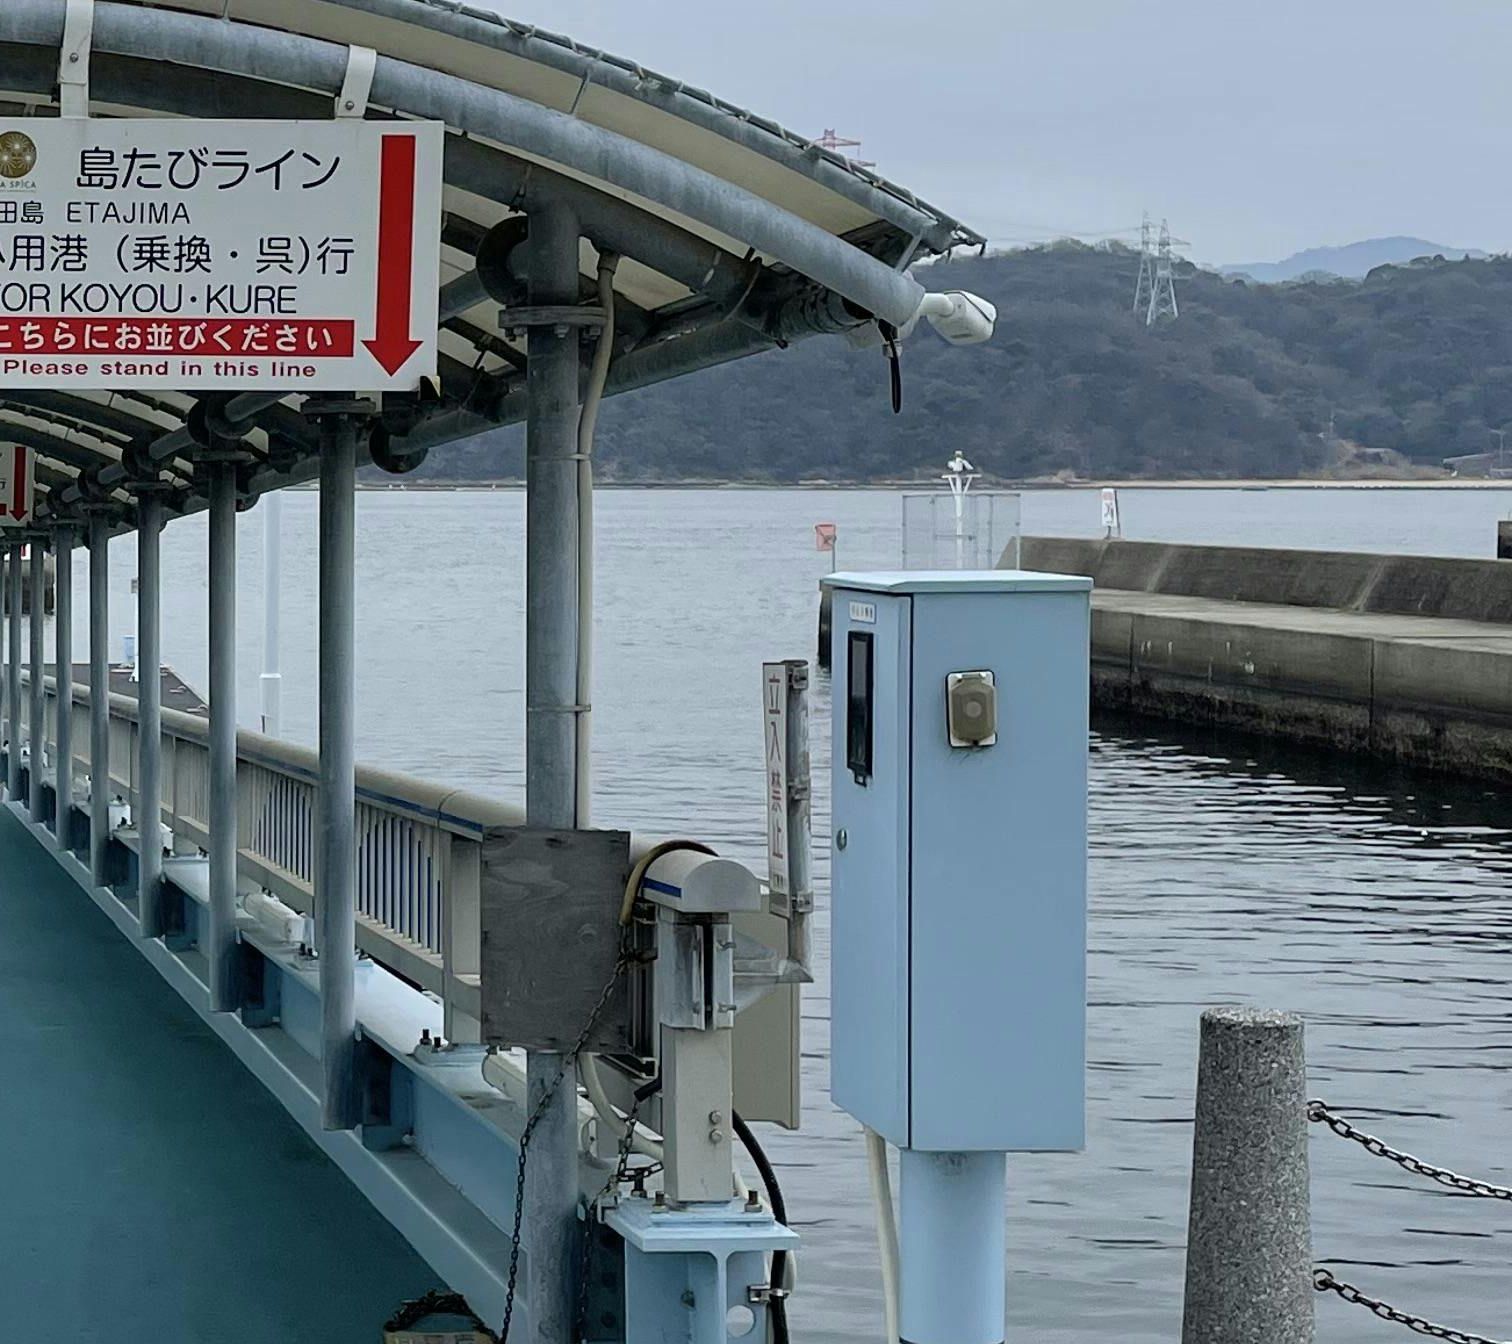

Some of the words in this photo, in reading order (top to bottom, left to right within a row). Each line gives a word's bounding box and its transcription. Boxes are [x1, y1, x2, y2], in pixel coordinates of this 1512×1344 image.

[77, 146, 340, 191] 島たびライン
[9, 178, 37, 190] SPICA
[66, 201, 191, 225] ETAJIMA
[3, 359, 89, 376] Please
[99, 360, 169, 376] stand
[180, 360, 202, 377] in
[213, 360, 260, 377] this
[271, 361, 317, 378] line
[768, 674, 784, 860] 立入禁止
